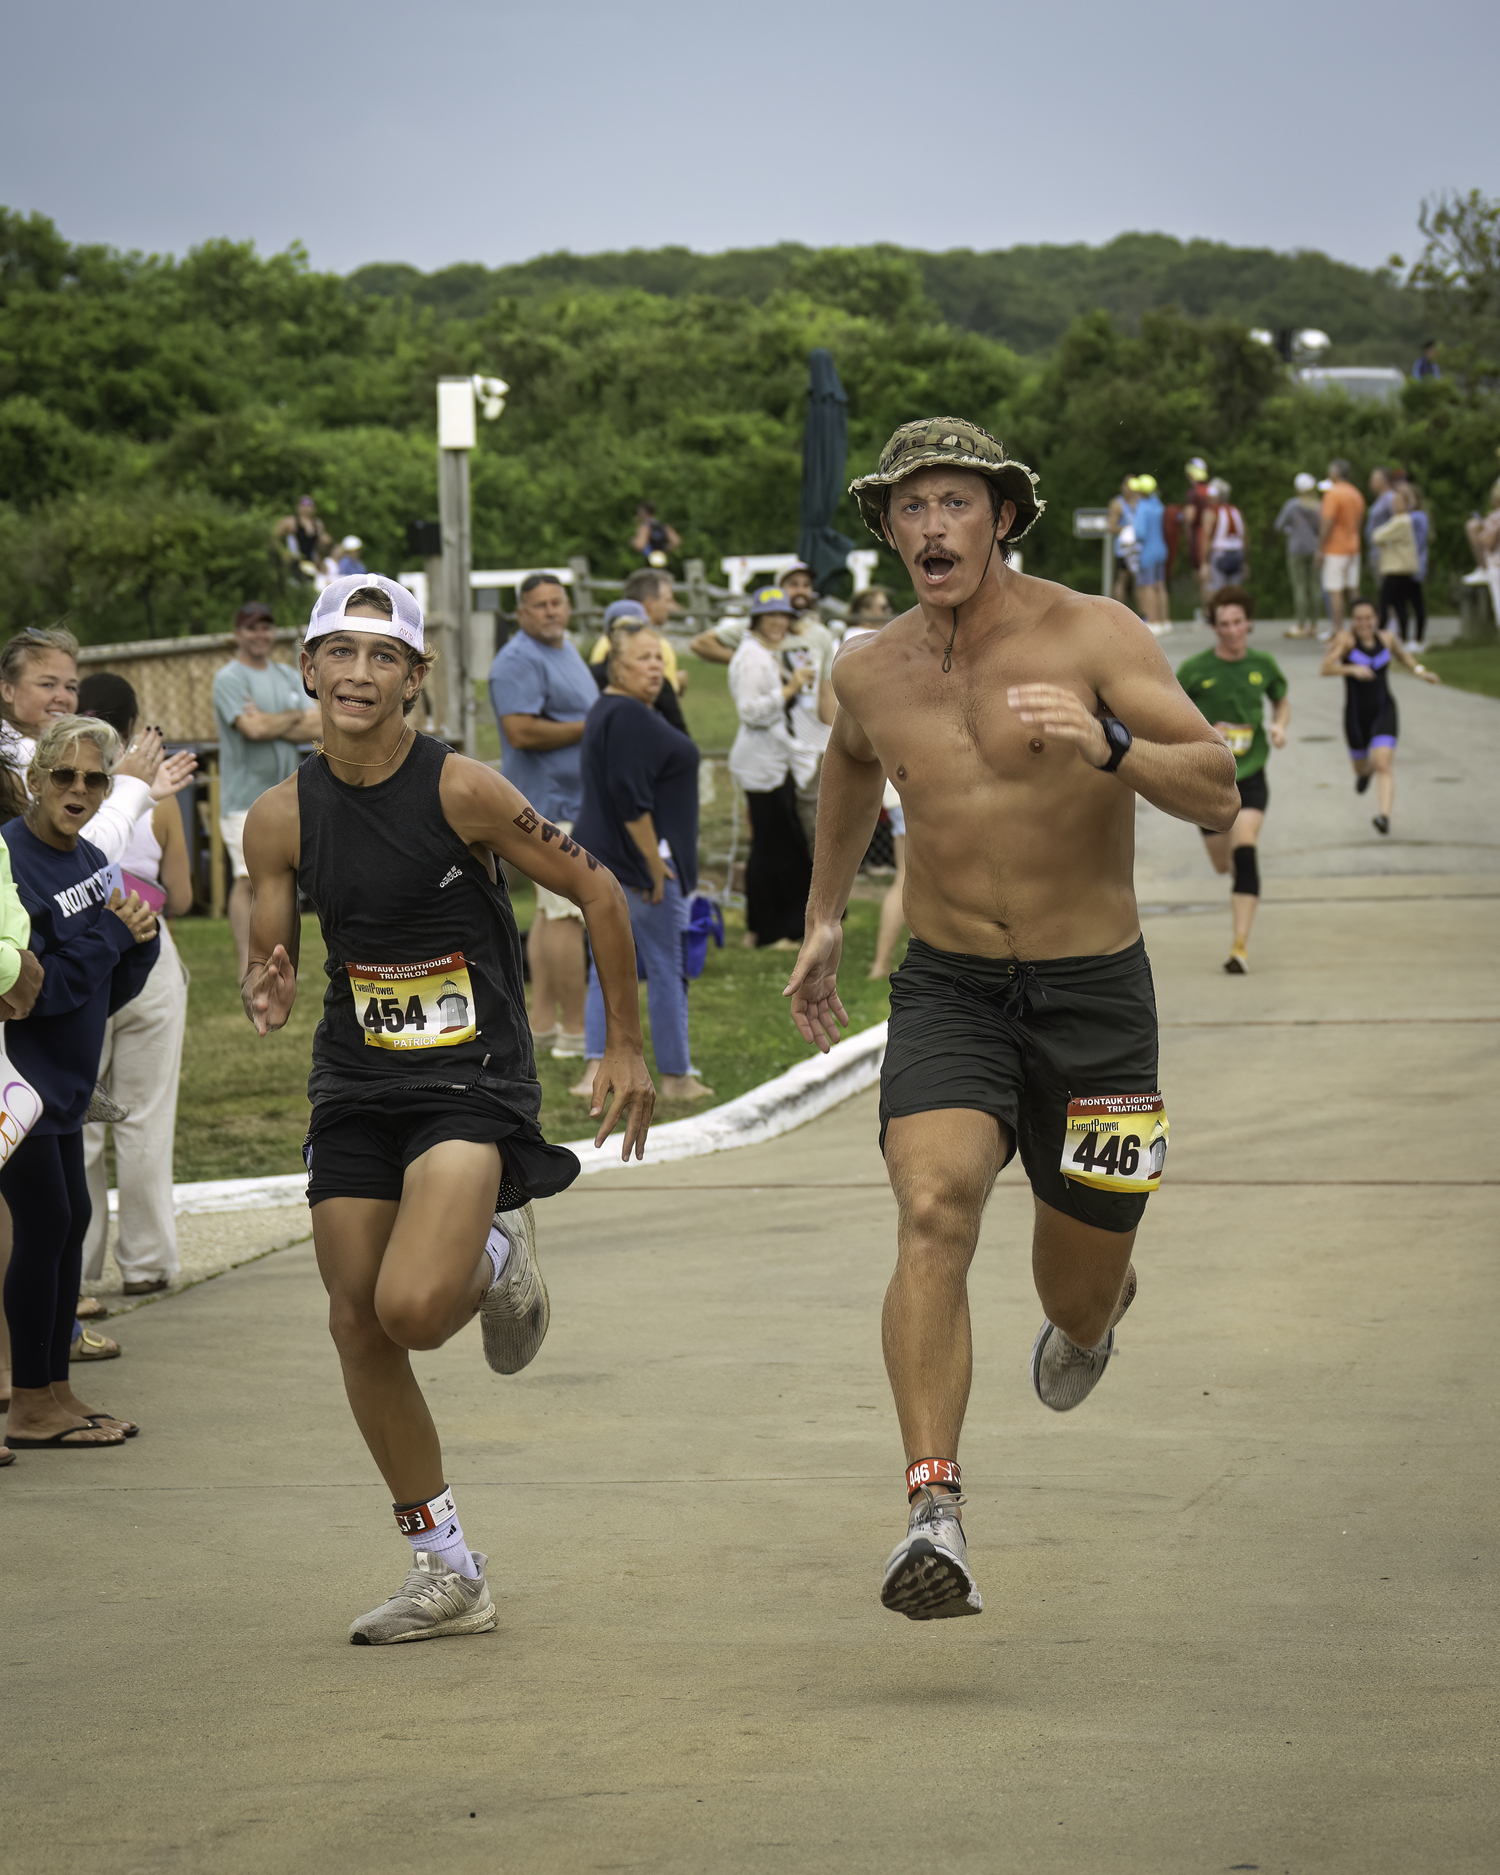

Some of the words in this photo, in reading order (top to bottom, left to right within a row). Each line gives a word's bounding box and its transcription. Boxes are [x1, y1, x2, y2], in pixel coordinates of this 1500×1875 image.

[513, 807, 539, 834] EP
[439, 868, 463, 888] adidas
[356, 964, 395, 973] MONTAUK
[396, 956, 453, 973] LIGHTHOUSE
[379, 969, 428, 980] TRIATHLON
[353, 980, 395, 995] EventPower
[363, 994, 428, 1034] 454
[393, 1036, 438, 1048] PATRICK
[1080, 1097, 1123, 1107] MONTAUK
[1106, 1104, 1153, 1113] TRIATHLON
[1071, 1118, 1120, 1132] EventPower
[1072, 1131, 1141, 1177] 446
[909, 1463, 930, 1488] 446
